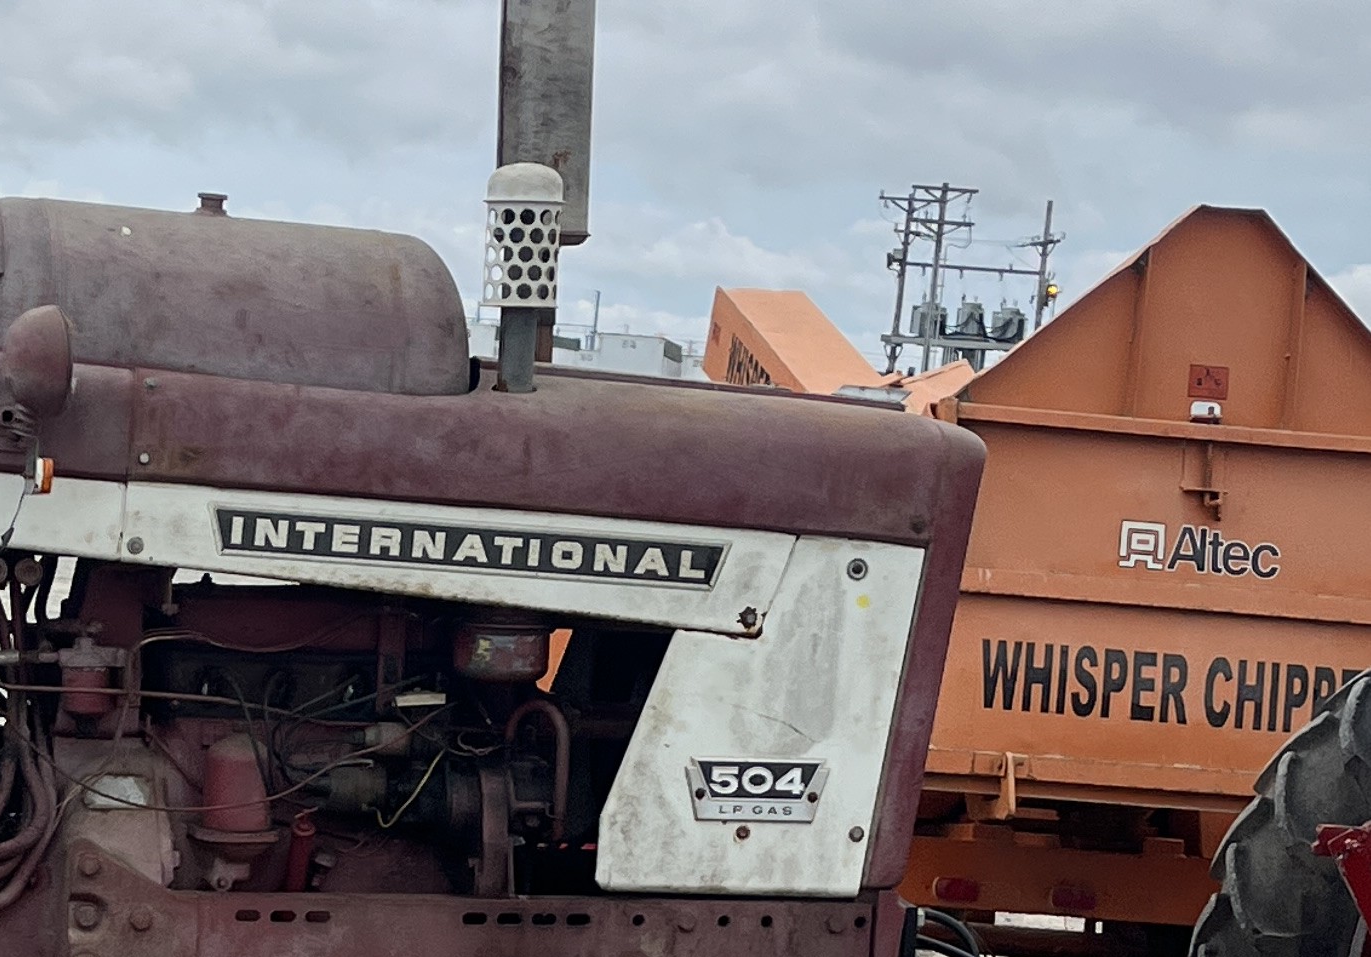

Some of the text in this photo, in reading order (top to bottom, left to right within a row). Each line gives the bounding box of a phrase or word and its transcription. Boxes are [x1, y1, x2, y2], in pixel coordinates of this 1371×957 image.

[229, 515, 708, 580] INTERNATIONAL
[1166, 525, 1281, 578] Altec
[982, 638, 1371, 733] WHISPER CHIPP
[709, 765, 806, 795] 504
[752, 805, 792, 816] GAS
